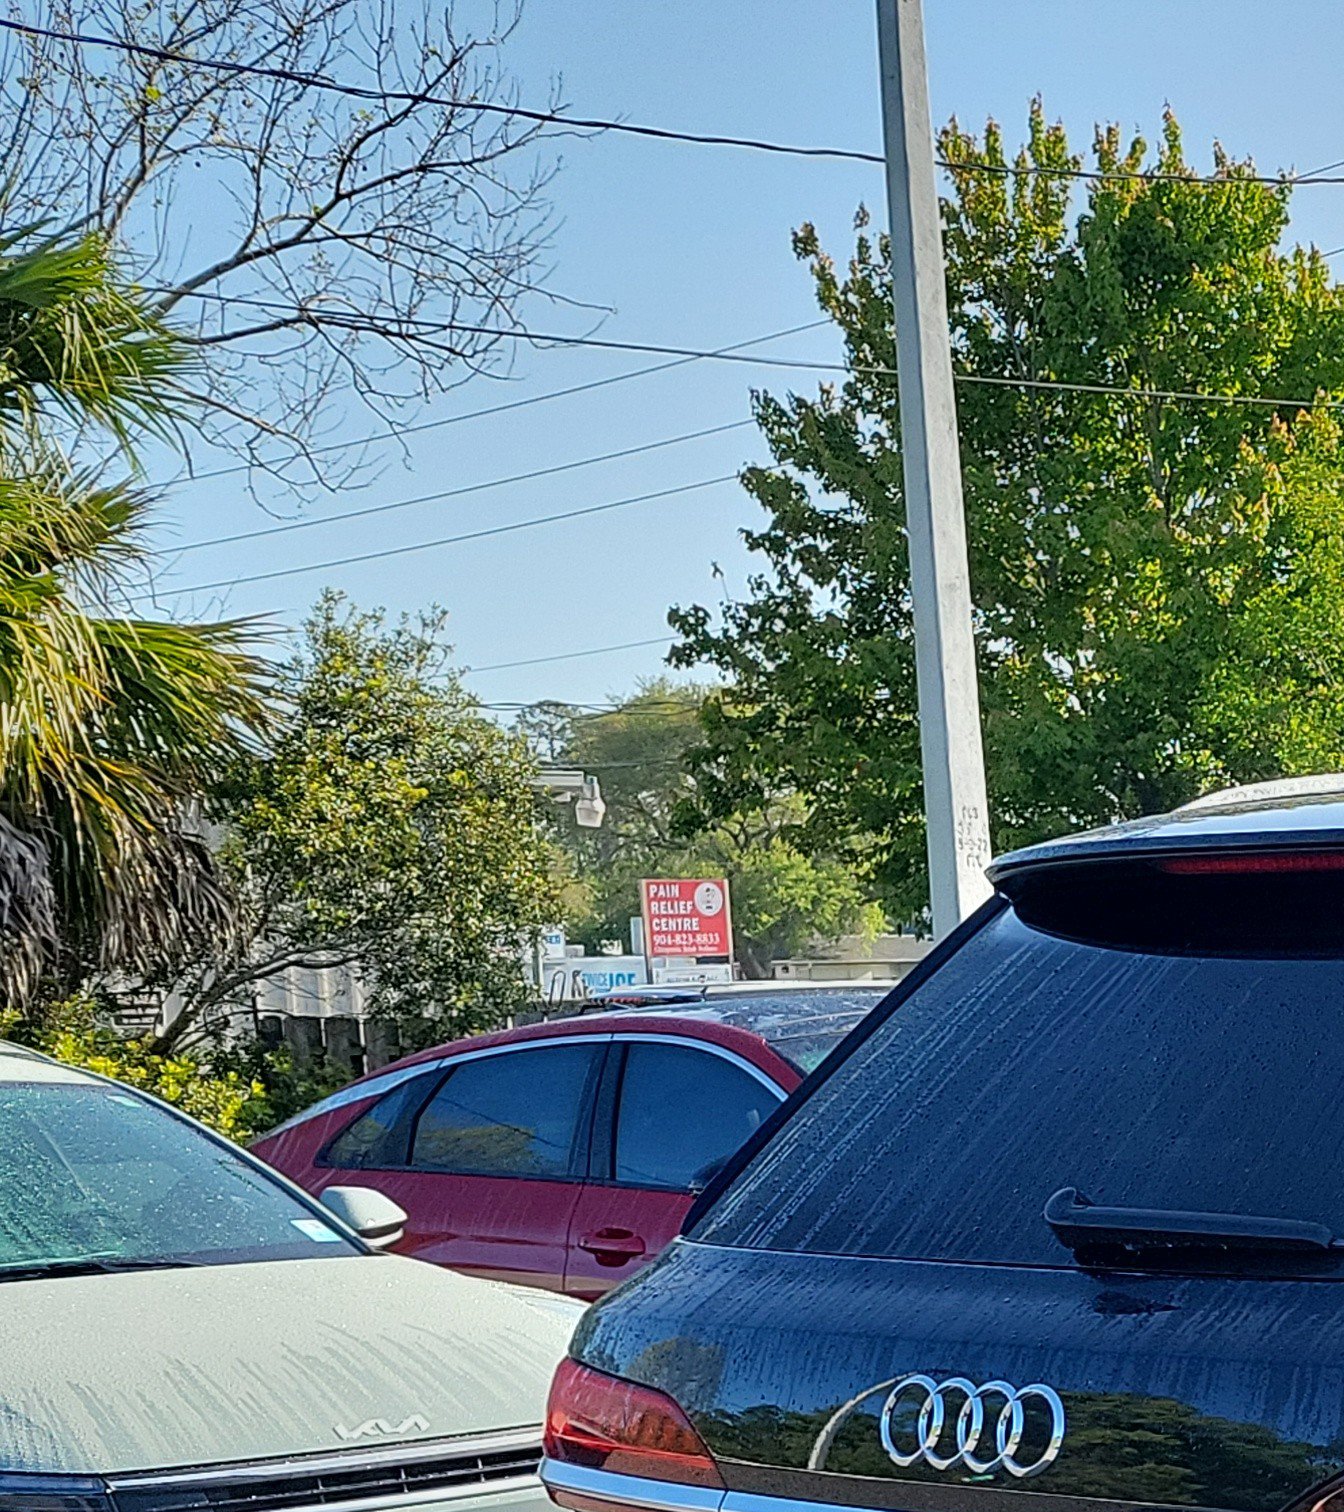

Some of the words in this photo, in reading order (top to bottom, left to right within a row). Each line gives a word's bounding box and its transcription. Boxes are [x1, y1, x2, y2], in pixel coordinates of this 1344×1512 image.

[649, 884, 680, 898] PAIN
[650, 900, 693, 915] RELIEF
[652, 917, 700, 931] CENTRE
